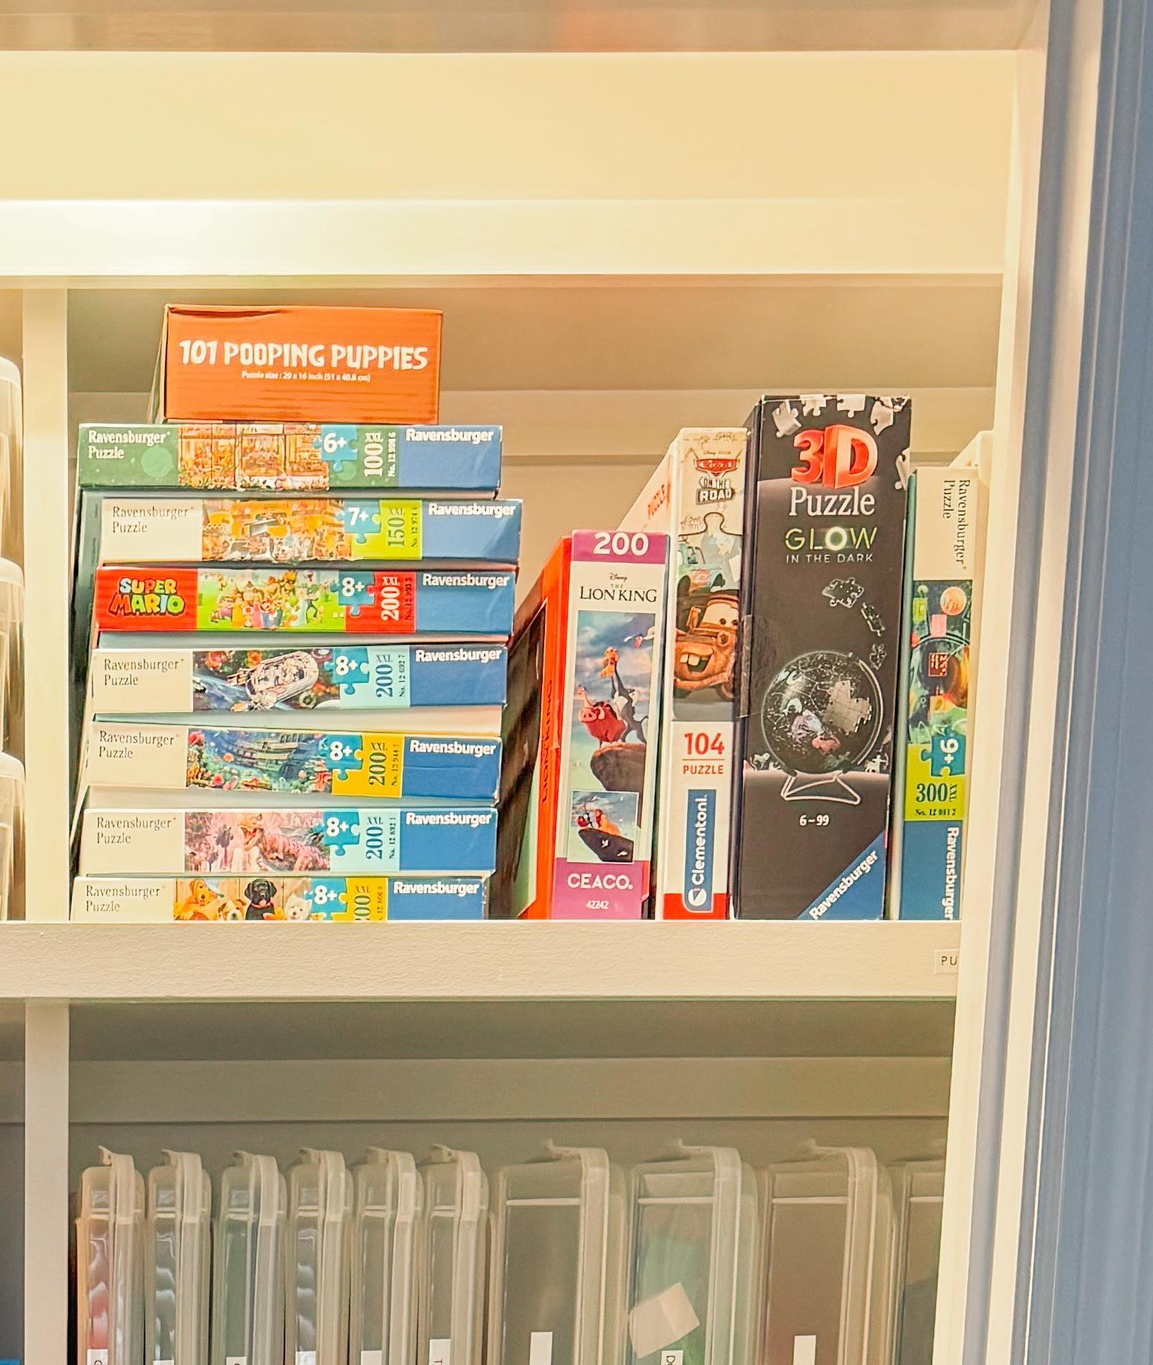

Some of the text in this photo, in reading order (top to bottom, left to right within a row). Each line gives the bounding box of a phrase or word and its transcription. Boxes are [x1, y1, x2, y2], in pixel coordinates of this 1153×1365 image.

[179, 339, 428, 370] 101 POOPING PUPPIES
[88, 430, 167, 446] Ravensburger
[406, 428, 494, 444] Ravensburger
[88, 447, 124, 459] Puzzle
[791, 424, 878, 490] 3D
[788, 487, 875, 516] Puzzle
[943, 479, 956, 519] Puzzle
[112, 506, 189, 520] Ravensburger
[428, 503, 516, 518] Ravensburger
[112, 521, 147, 534] Puzzle
[593, 531, 649, 557] 200
[785, 527, 878, 551] GLOW
[786, 553, 873, 563] IN THE DARK
[119, 577, 177, 594] SUPER
[422, 573, 509, 589] Ravensburger
[579, 585, 658, 603] LION KING
[108, 593, 186, 617] MARIO
[415, 649, 502, 664] Ravensburger
[104, 658, 180, 672] Ravensburger
[104, 674, 139, 686] Puzzle
[99, 730, 175, 747] Ravensburger
[684, 732, 725, 755] 104
[98, 746, 134, 759] Puzzle
[410, 739, 496, 757] Ravensburger
[682, 764, 724, 775] PUZZLE
[97, 816, 172, 831] Ravensburger
[406, 812, 492, 826] Ravensburger
[97, 832, 131, 844] Puzzle
[941, 826, 960, 920] Ravensburger
[86, 884, 161, 899] Ravensburger
[393, 881, 479, 898] Ravensburger
[808, 850, 879, 920] Ravensburger
[86, 900, 120, 912] Puzzle
